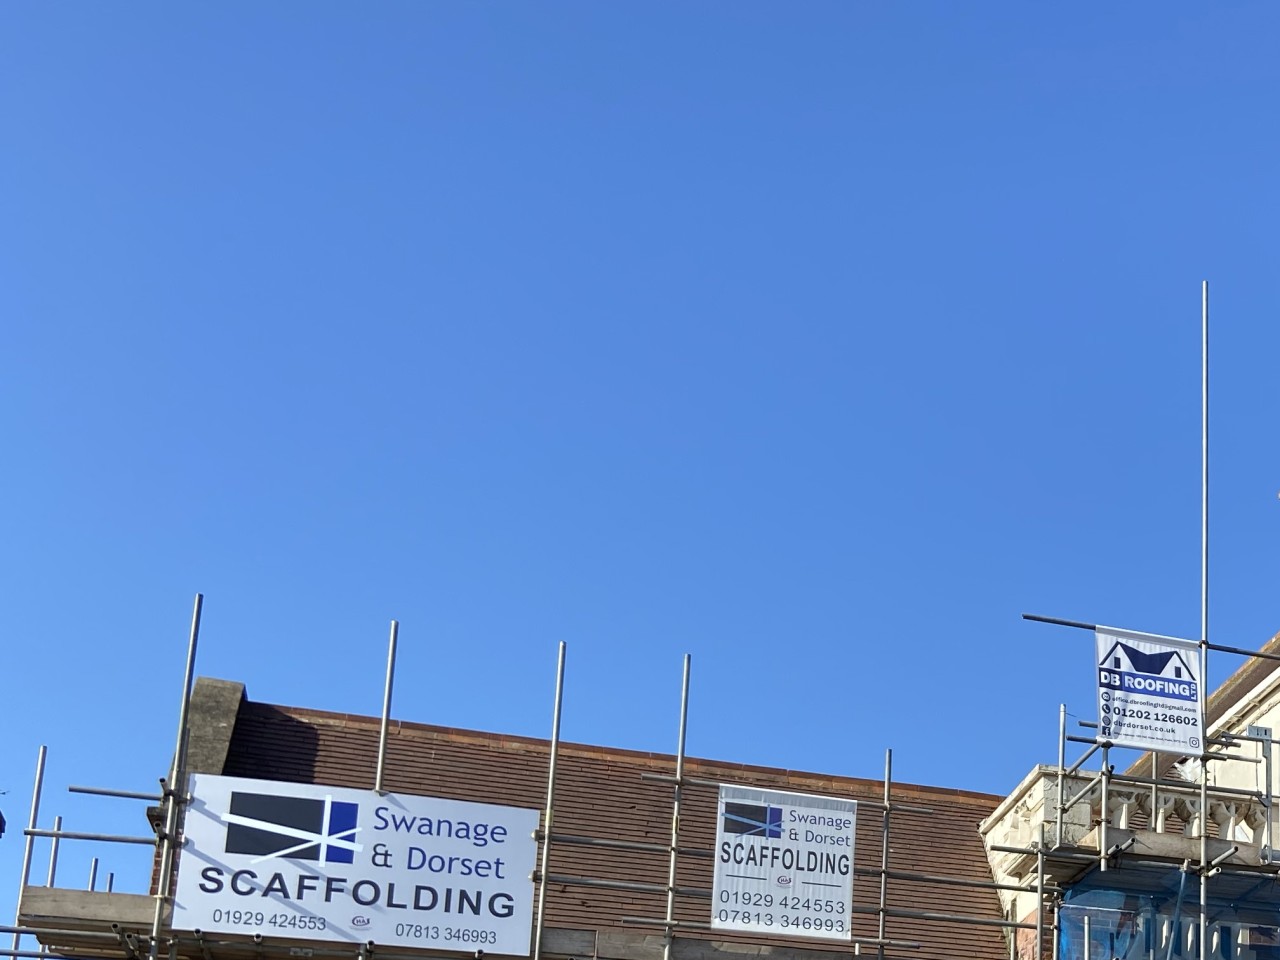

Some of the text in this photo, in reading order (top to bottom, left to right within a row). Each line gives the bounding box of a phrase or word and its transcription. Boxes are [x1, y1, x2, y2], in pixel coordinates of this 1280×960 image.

[1100, 671, 1190, 696] DB ROOFING
[1113, 707, 1198, 726] 01202 126602
[1114, 720, 1176, 734] dbrdorset.co.uk
[374, 806, 508, 847] Swanage
[790, 810, 852, 830] Swanage
[789, 828, 851, 847] & Dorset
[372, 843, 505, 879] & Dorset
[720, 842, 850, 876] SCAFFOLDING
[198, 867, 515, 918] SCAFFOLDING
[720, 890, 845, 914] 01929 424553
[213, 909, 326, 931] 01929 424553
[719, 909, 845, 932] 07813 346993
[396, 923, 497, 944] 07813 346993
